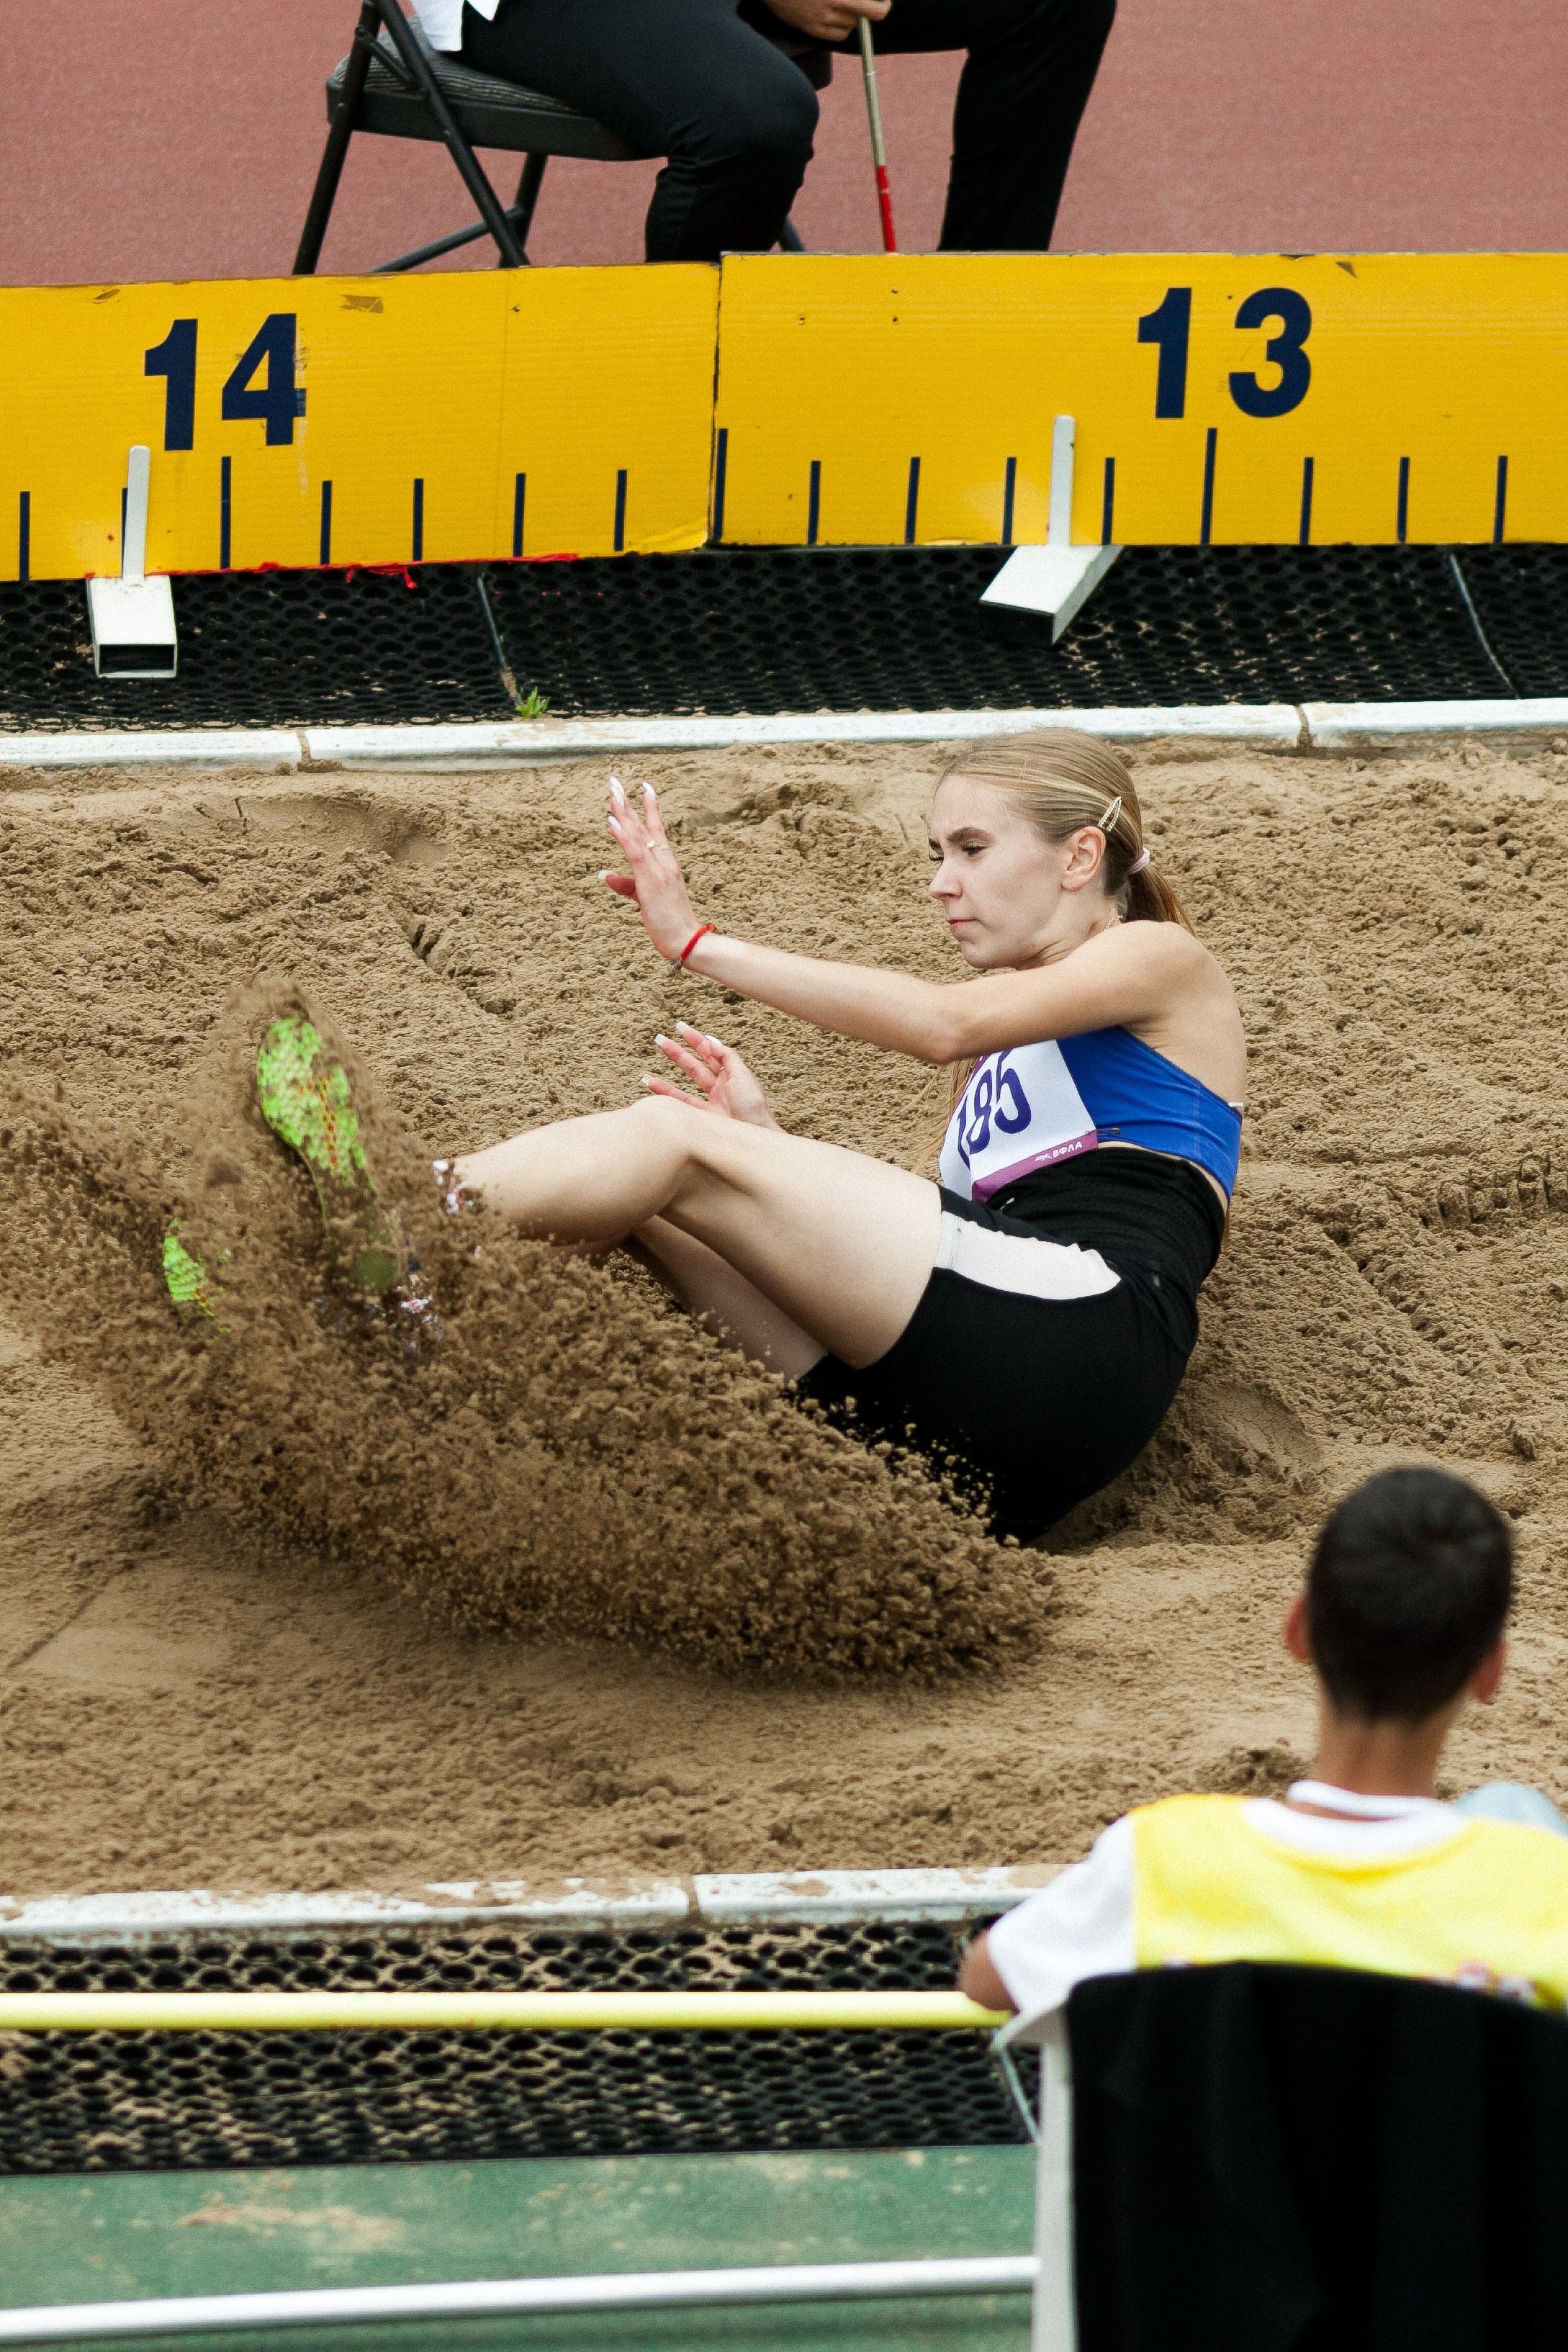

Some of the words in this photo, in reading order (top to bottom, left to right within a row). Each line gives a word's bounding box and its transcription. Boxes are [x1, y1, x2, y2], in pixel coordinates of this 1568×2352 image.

[145, 313, 307, 451] 14
[1137, 287, 1312, 419] 13
[957, 1049, 1032, 1171] 185
